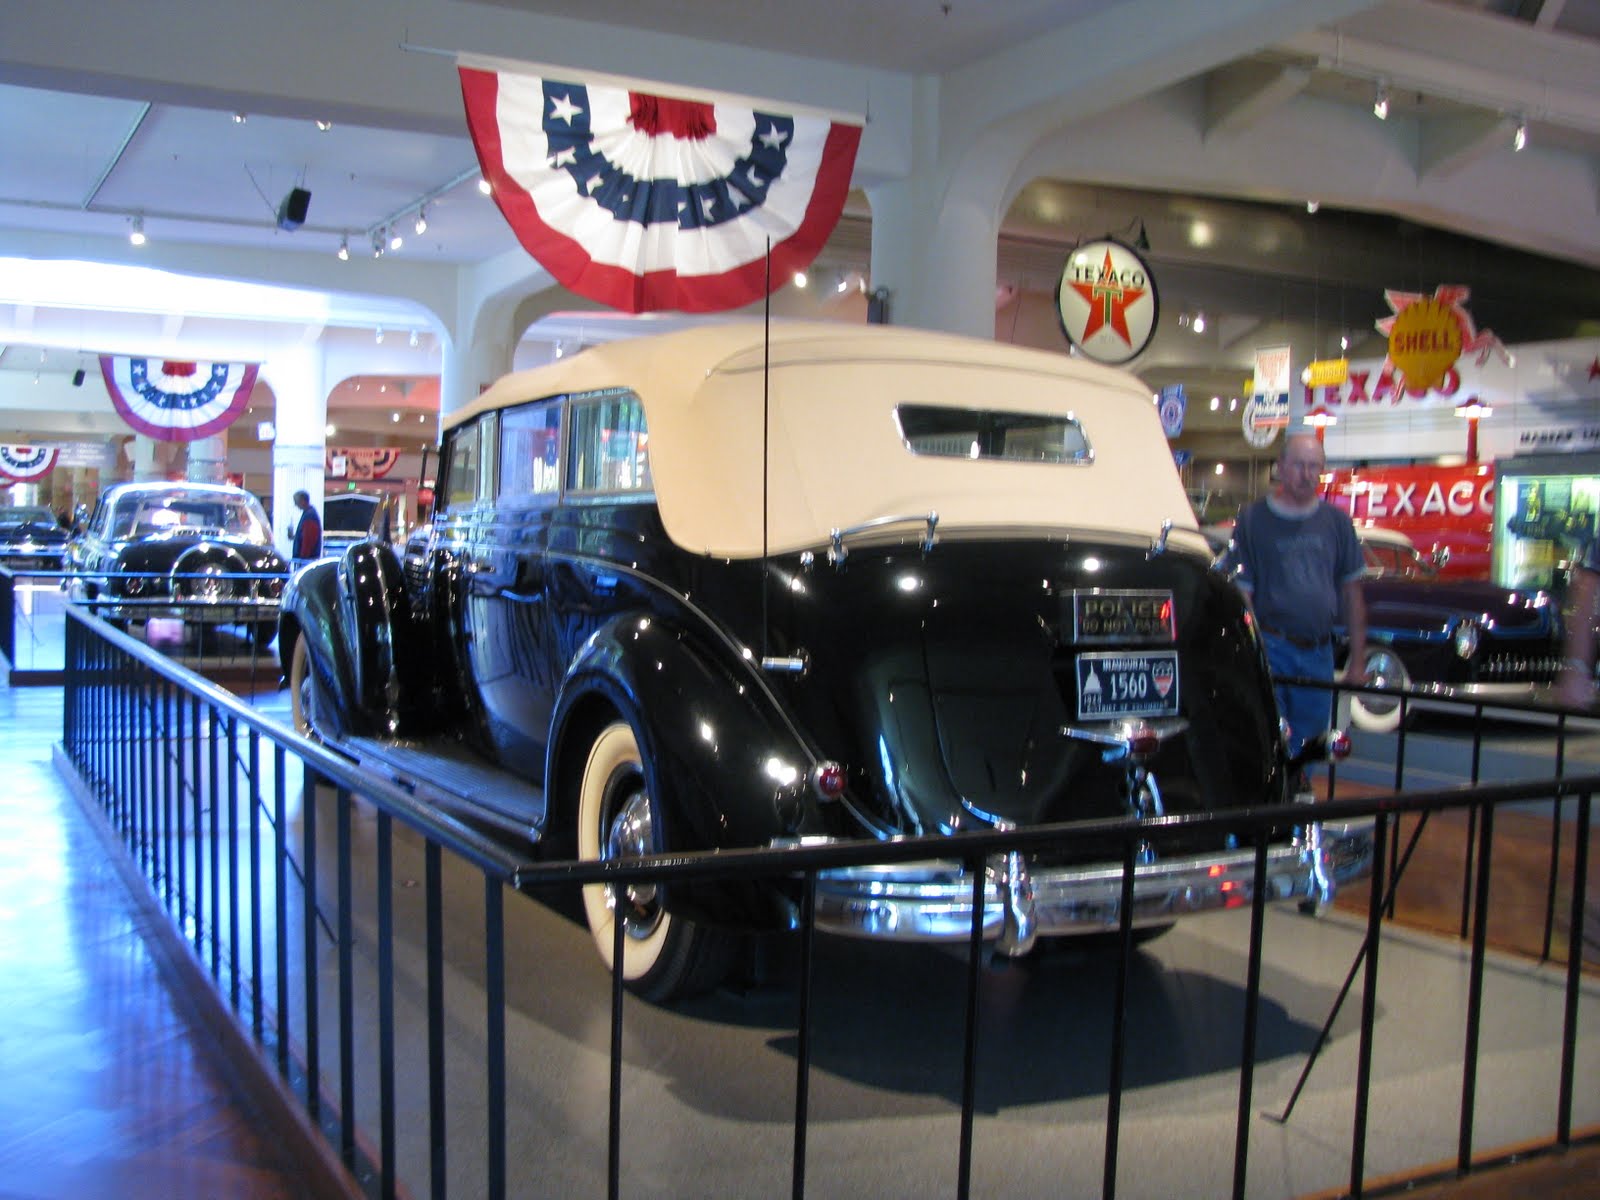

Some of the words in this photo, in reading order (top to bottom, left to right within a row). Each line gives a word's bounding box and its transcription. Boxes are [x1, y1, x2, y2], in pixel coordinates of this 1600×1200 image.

[1075, 265, 1145, 289] TEXACO
[1395, 328, 1456, 354] SHELL
[1302, 365, 1461, 406] EXAO
[1342, 479, 1494, 518] TEXACO
[1085, 599, 1163, 619] POLICE
[1109, 673, 1148, 701] 1560
